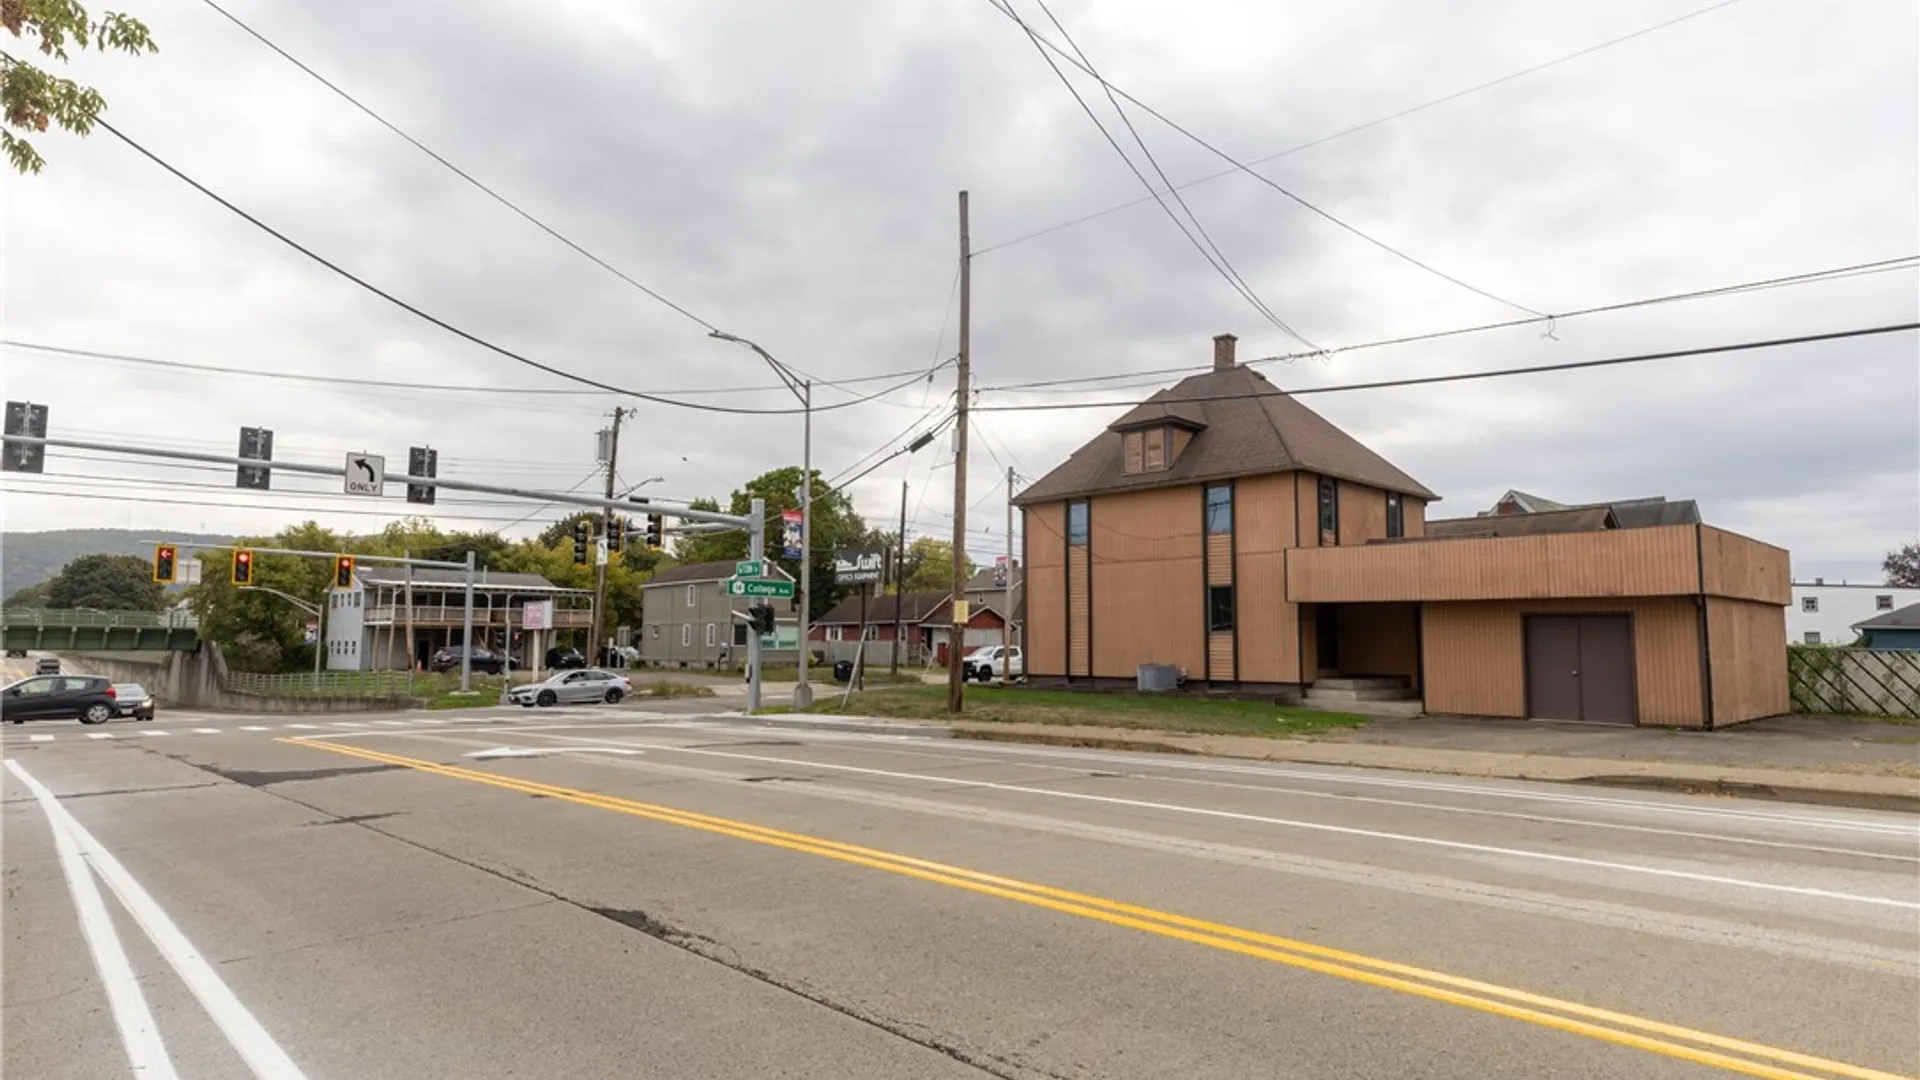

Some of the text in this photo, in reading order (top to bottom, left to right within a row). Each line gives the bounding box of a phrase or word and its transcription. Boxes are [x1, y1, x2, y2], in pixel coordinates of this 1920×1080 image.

[351, 482, 378, 492] ONLY
[836, 553, 882, 571] Swift
[747, 584, 777, 596] College
